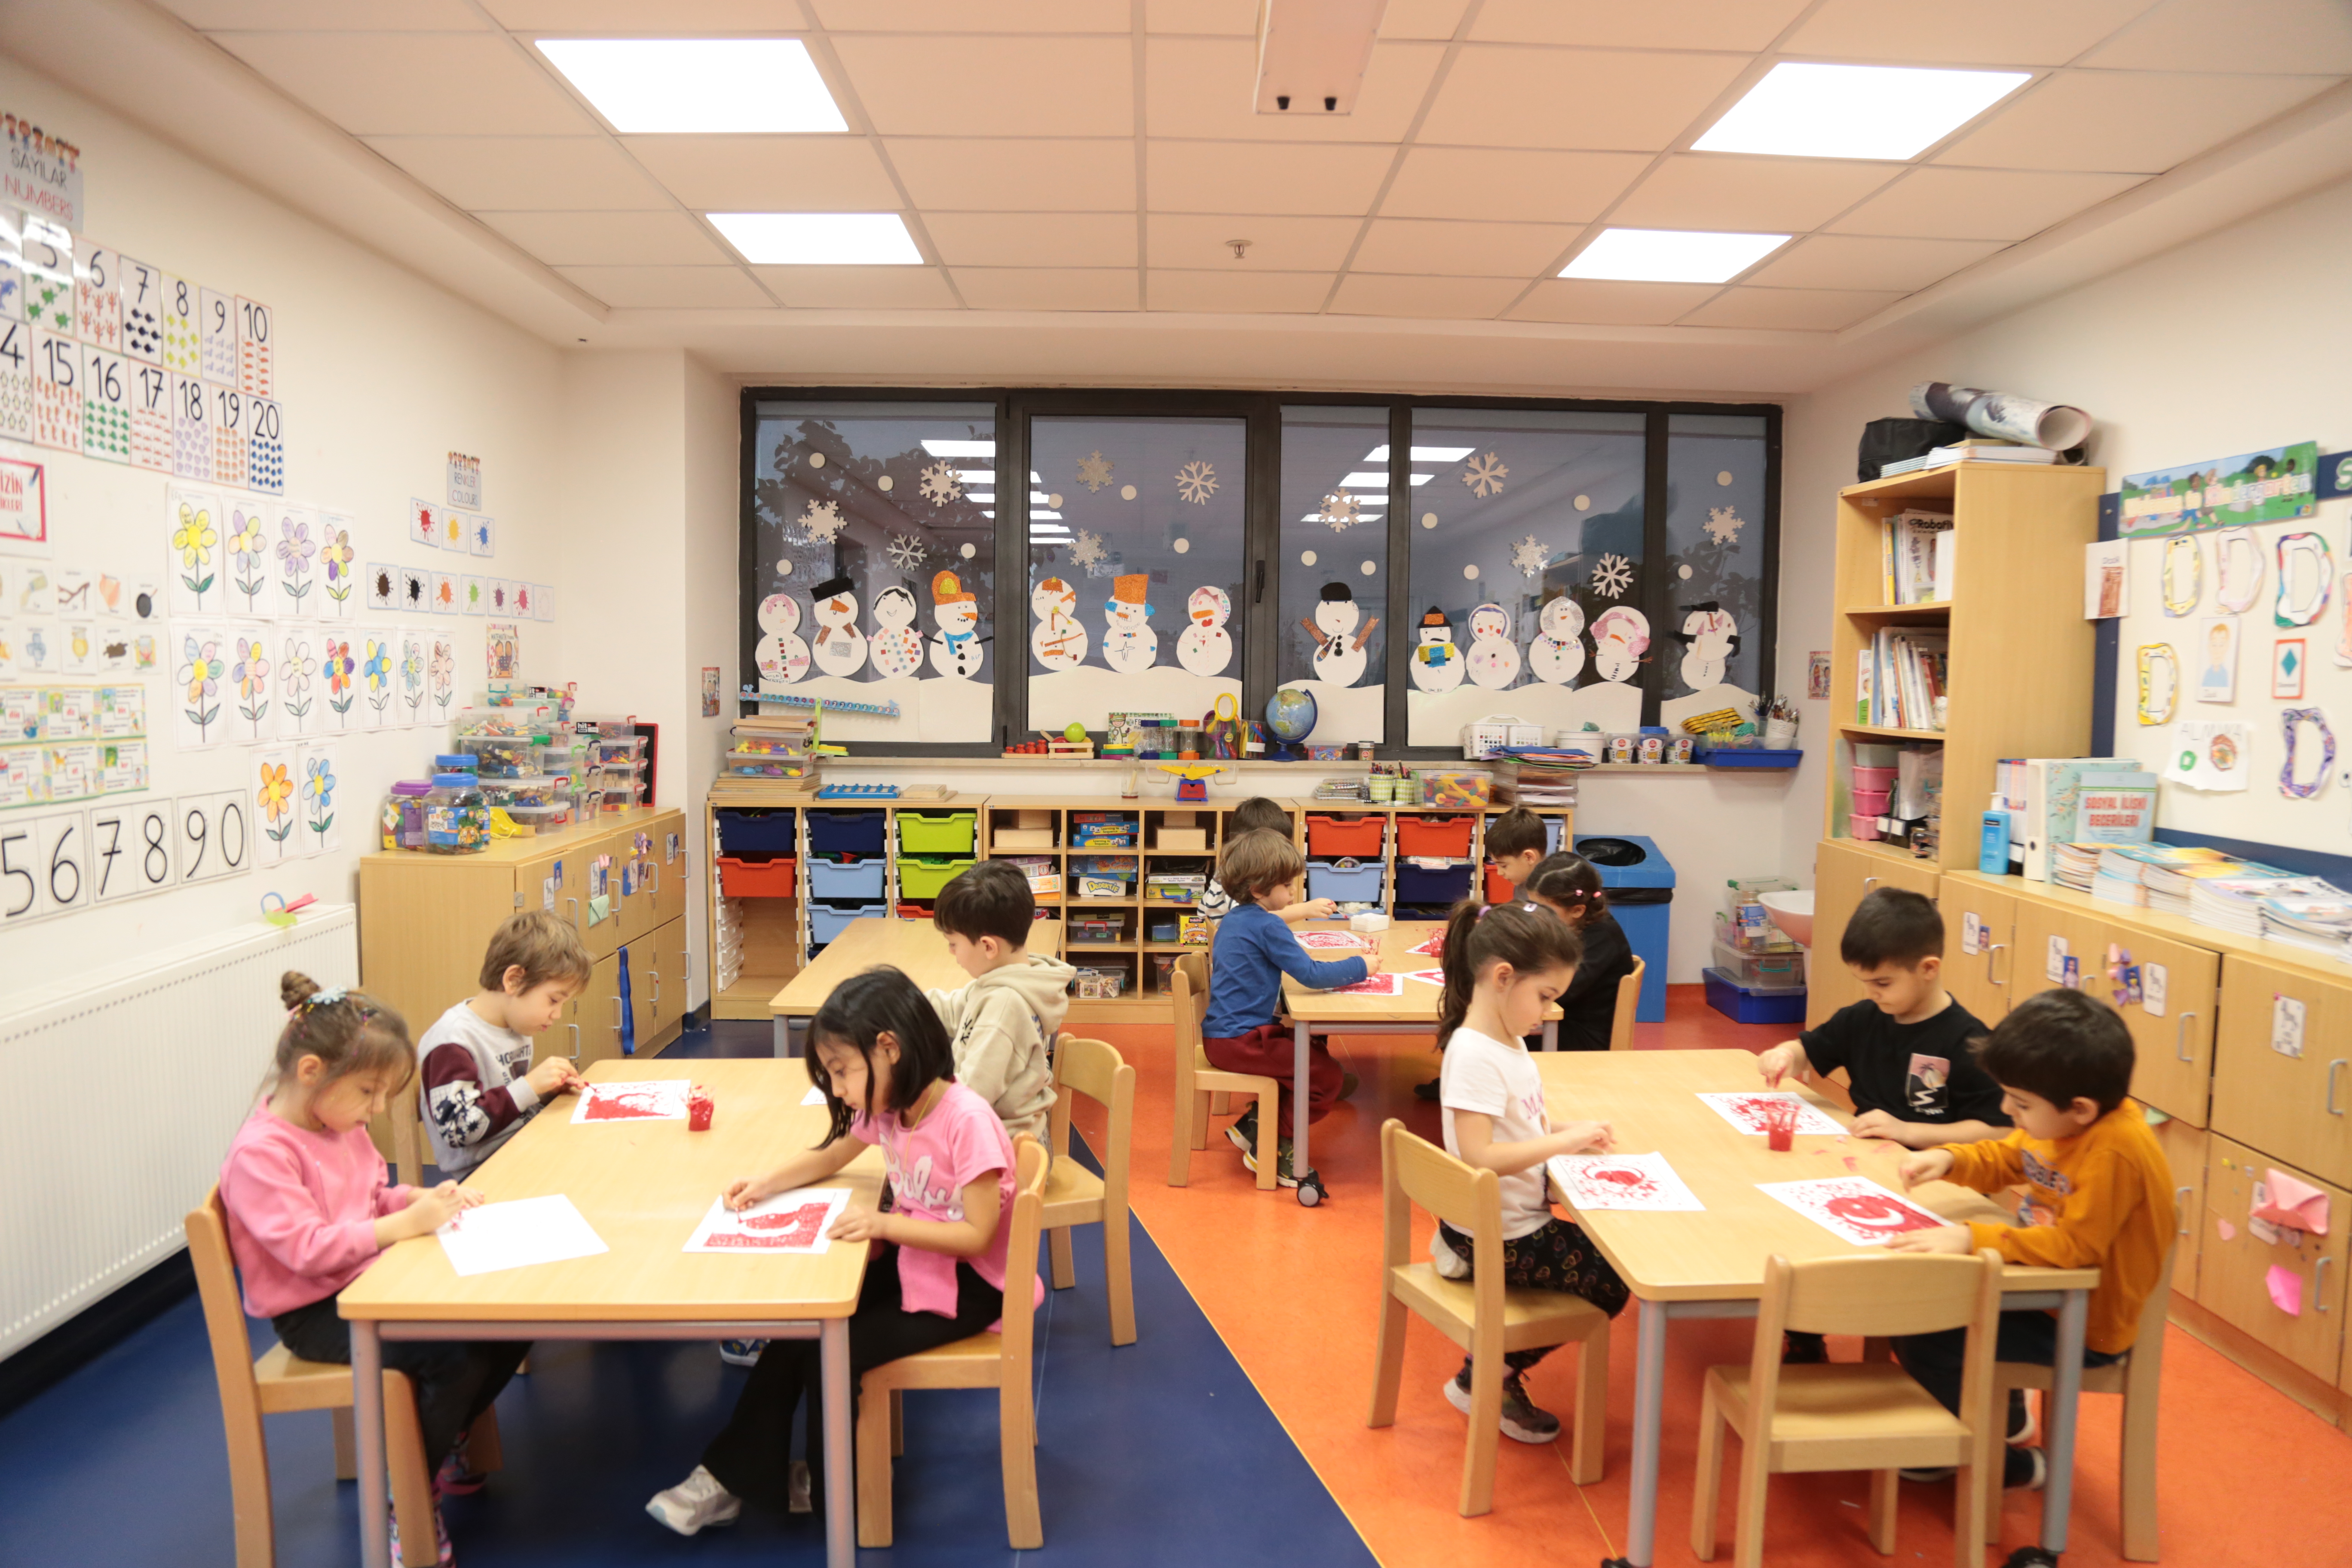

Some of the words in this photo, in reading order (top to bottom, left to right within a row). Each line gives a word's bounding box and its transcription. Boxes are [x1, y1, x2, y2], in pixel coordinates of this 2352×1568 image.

[11, 148, 67, 190] SAYILAR
[5, 173, 73, 221] NUMBERS
[90, 251, 104, 288] 6
[136, 266, 149, 303] 7
[177, 281, 189, 316] 8
[215, 301, 225, 333] 9
[244, 303, 267, 342] 10
[43, 338, 74, 386] 15
[92, 356, 121, 402] 16
[140, 367, 163, 408] 17
[180, 380, 202, 421] 18
[218, 390, 239, 428] 19
[253, 401, 279, 440] 20
[452, 490, 478, 506] COLOURS
[454, 472, 476, 488] RENKLER
[2086, 797, 2117, 809] SOSYAL
[1, 834, 34, 917] 5
[51, 827, 80, 903] 6
[97, 820, 122, 896] 7
[144, 814, 168, 883] 8
[187, 810, 206, 878] 9
[221, 802, 244, 867] 0
